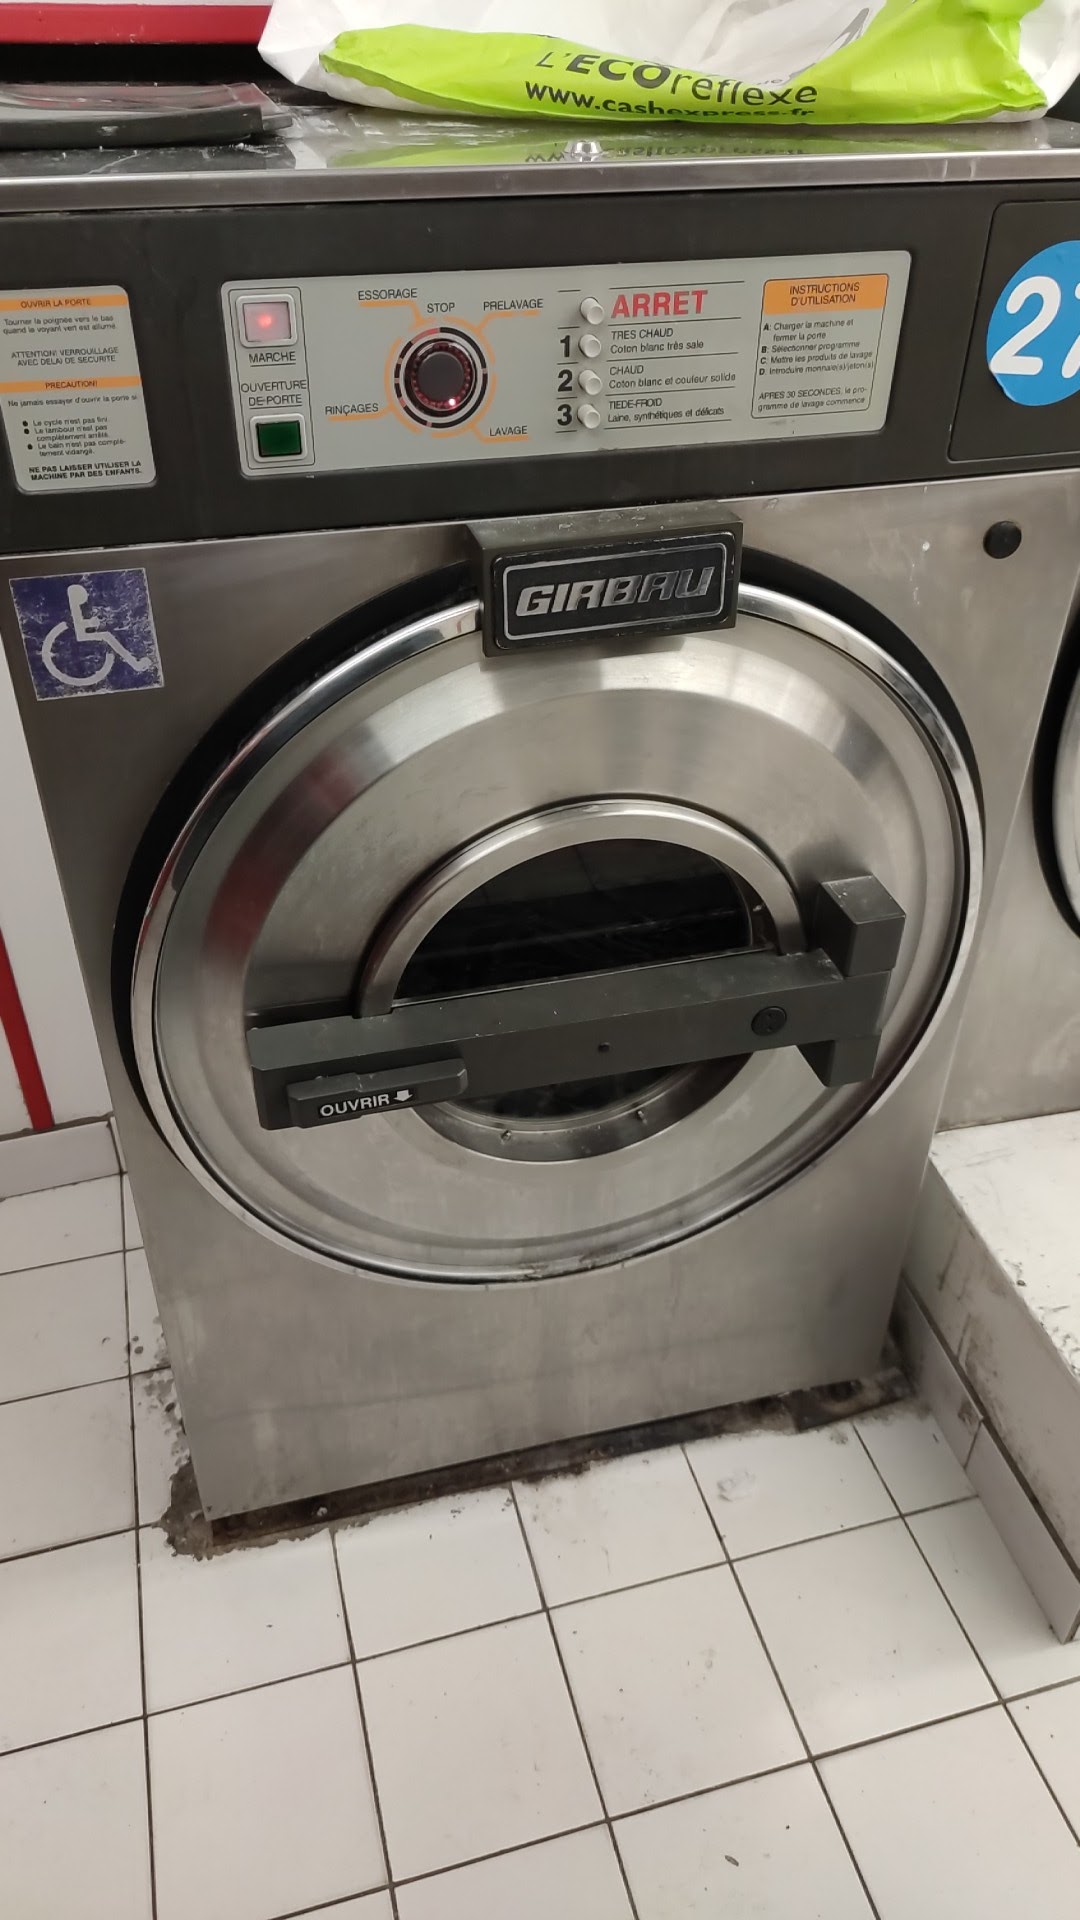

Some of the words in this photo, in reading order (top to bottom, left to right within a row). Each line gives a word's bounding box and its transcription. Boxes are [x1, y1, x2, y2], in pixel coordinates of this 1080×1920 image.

[525, 80, 815, 118] www.cashexpress.fr
[358, 288, 418, 300] ESSORAGE
[790, 282, 860, 295] INSTRUCTIONS
[21, 300, 50, 308] OUVRIR
[483, 298, 544, 312] PRELAVAGE
[610, 290, 708, 318] ARRET
[791, 294, 856, 307] D'UTILISATION
[426, 302, 455, 314] STOP
[3, 326, 26, 335] quand
[38, 326, 62, 334] voyant
[774, 322, 804, 332] Charger
[814, 319, 845, 328] machine
[611, 330, 637, 340] TRES
[639, 327, 674, 340] CHAUD
[773, 334, 796, 342] fermer
[806, 332, 826, 342] porte
[60, 347, 119, 356] VERROUILLAGE
[560, 335, 571, 358] 1
[610, 344, 638, 354] Coton
[640, 342, 664, 352] blanc
[667, 340, 684, 350] très
[686, 339, 704, 349] sale
[818, 341, 860, 351] programme
[18, 358, 38, 366] AVEC
[78, 355, 116, 364] SECURITE
[248, 351, 296, 364] MARCHE
[770, 356, 793, 364] Mettre
[795, 355, 806, 363] les
[807, 352, 837, 363] produits
[838, 352, 848, 360] de
[850, 350, 873, 361] lavage
[610, 364, 644, 376] CHAUD
[770, 365, 803, 375] Introduire
[240, 380, 307, 393] OUVERTURE
[557, 369, 573, 392] 2
[608, 378, 636, 389] Coton
[638, 376, 662, 388] blanc
[664, 376, 674, 385] et
[676, 374, 708, 385] couleur
[710, 372, 736, 382] solide
[758, 390, 788, 400] APRES
[787, 390, 795, 398] 30
[20, 400, 44, 408] jamais
[46, 398, 72, 407] essayer
[325, 402, 379, 416] RINÇAGES
[608, 398, 663, 410] TIEDE-FROID
[758, 402, 788, 412] gramme
[790, 400, 799, 409] de
[802, 400, 824, 409] lavage
[826, 397, 866, 406] commence
[557, 404, 573, 426] 3
[608, 412, 632, 423] Laine,
[634, 410, 683, 422] synthétiques
[685, 408, 694, 417] et
[695, 406, 724, 416] délicats
[44, 418, 62, 427] cycle
[489, 425, 528, 437] LAVAGE
[60, 464, 92, 472] LAISSER
[95, 461, 130, 470] UTILISER
[31, 472, 68, 481] MACHINE
[515, 566, 716, 617] GIRBAU
[320, 1094, 390, 1117] OUVRIR
